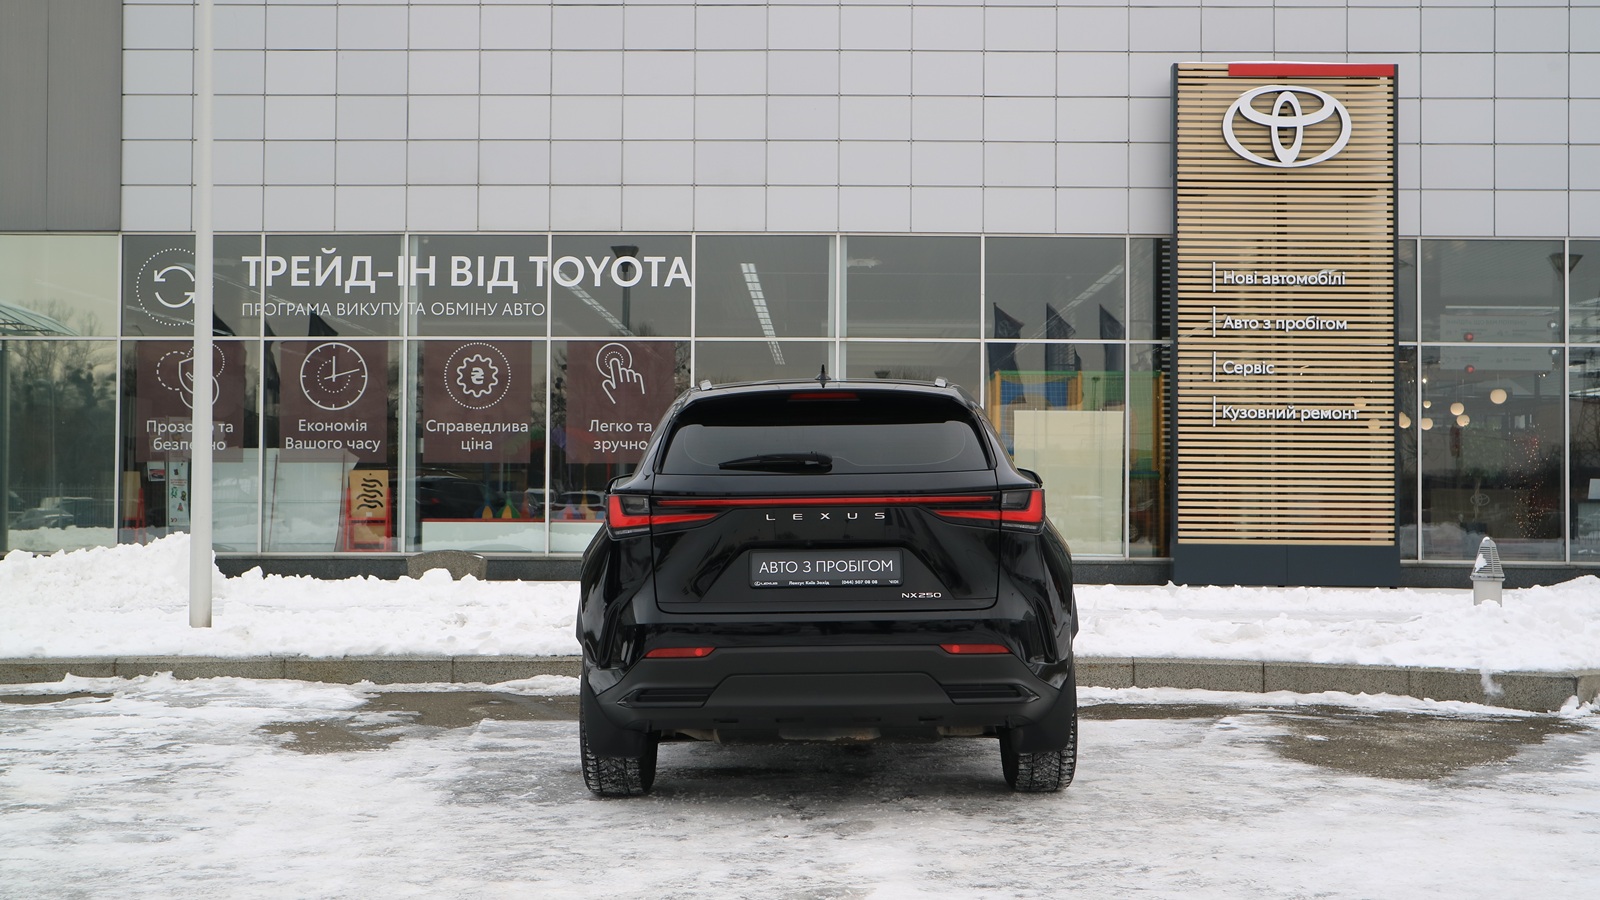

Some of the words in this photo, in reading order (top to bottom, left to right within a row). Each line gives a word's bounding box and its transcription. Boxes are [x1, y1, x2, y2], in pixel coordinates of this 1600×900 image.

[241, 247, 436, 294] ТРЕЙД-ІН
[451, 255, 518, 294] ВІД
[529, 255, 692, 288] TOYOTA
[1222, 270, 1258, 285] Нові
[1262, 271, 1346, 286] автомобілі
[242, 302, 331, 316] ПРОГРАМА
[337, 302, 403, 316] ВИКУПУ
[407, 302, 426, 316] ТА
[431, 302, 498, 316] ОБМІНУ
[502, 302, 545, 316] АВТО
[1222, 316, 1259, 330] Авто
[1262, 318, 1271, 330] з
[1275, 316, 1348, 332] пробігом
[1222, 361, 1275, 377] Сервіс
[1222, 405, 1296, 422] Кузовний
[1300, 408, 1360, 422] ремонт
[146, 420, 214, 435] Прозо
[218, 423, 234, 433] та
[298, 419, 367, 432] Економія
[425, 419, 529, 435] Справедлива
[589, 420, 632, 433] Легко
[636, 423, 652, 433] та
[153, 437, 226, 450] безпо
[285, 437, 342, 450] Вашого
[346, 439, 381, 453] часу
[461, 437, 493, 452] ціна
[593, 439, 648, 453] зручно
[766, 512, 885, 521] LEXUS
[759, 561, 798, 574] АВТО
[802, 560, 811, 573] З
[816, 559, 893, 573] ПРОБІГОМ
